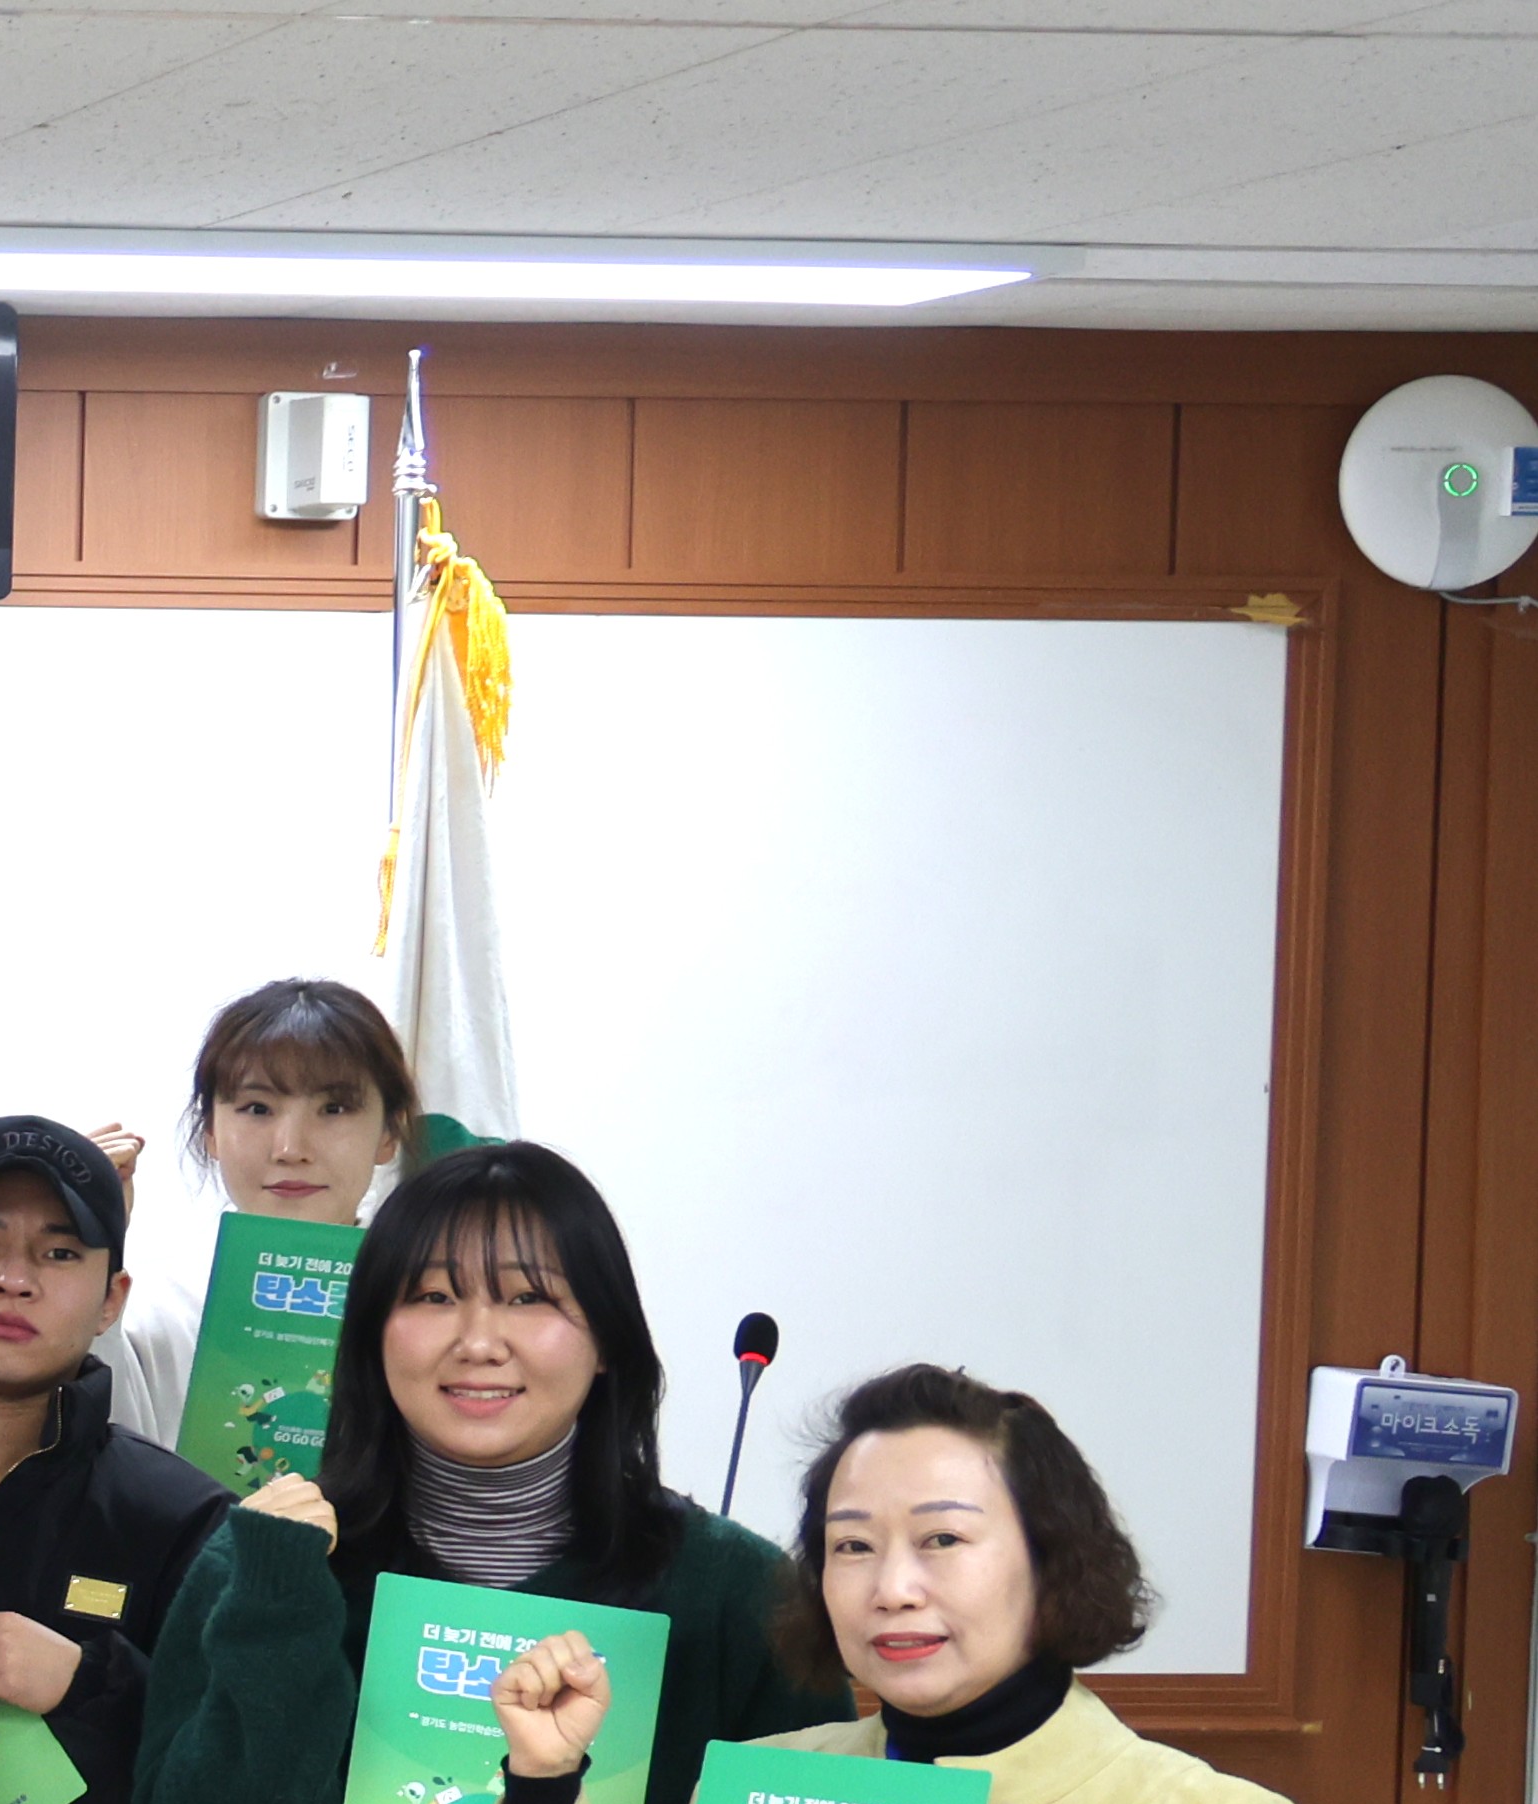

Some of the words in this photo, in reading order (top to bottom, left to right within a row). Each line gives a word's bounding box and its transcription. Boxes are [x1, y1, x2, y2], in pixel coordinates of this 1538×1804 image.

[257, 1252, 273, 1266] 더
[333, 1261, 354, 1275] 20
[1381, 1412, 1481, 1445] 마이크소독
[422, 1623, 440, 1640] 더
[443, 1626, 476, 1645] 늦기
[479, 1631, 512, 1651] 전에
[514, 1637, 537, 1653] 20
[416, 1646, 494, 1701] 탄소
